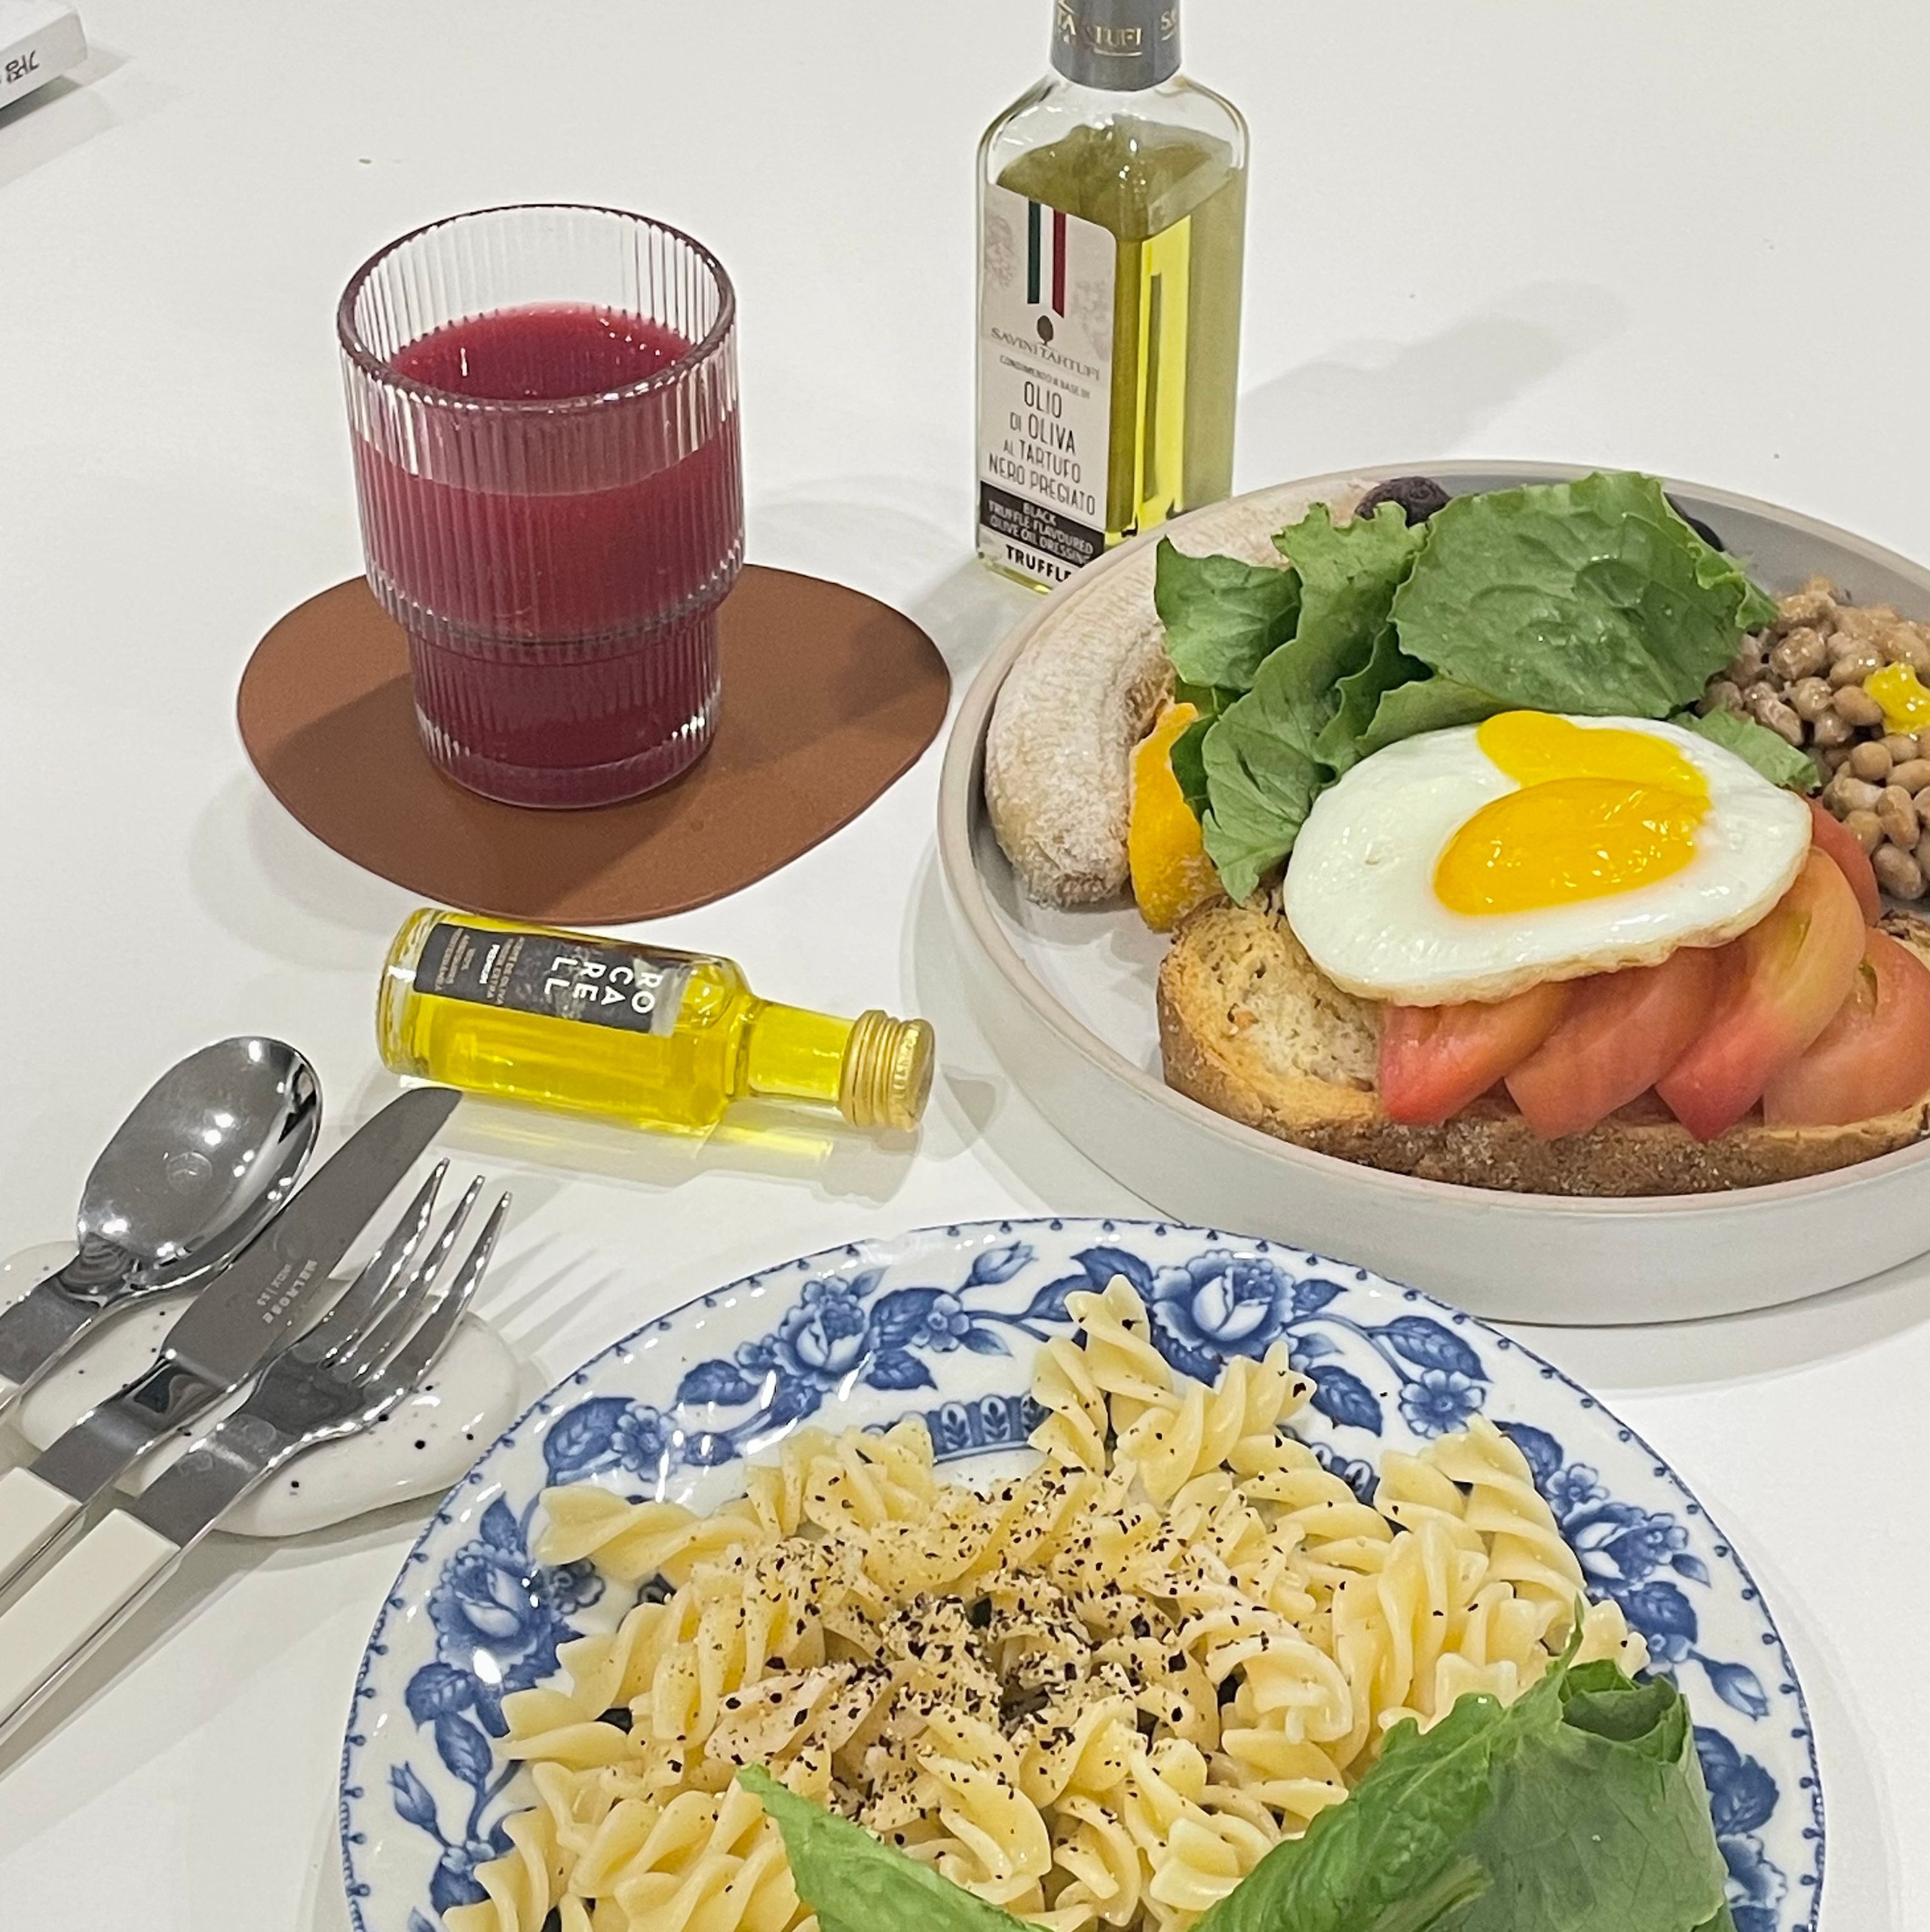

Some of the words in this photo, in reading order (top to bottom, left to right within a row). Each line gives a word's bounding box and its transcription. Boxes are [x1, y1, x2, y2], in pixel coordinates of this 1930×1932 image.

[1024, 381, 1062, 419] OLIO
[1009, 412, 1022, 432] DI
[1028, 413, 1076, 457] OLIVA
[1003, 440, 1015, 457] AL
[1019, 439, 1081, 483] TARTUFO
[989, 452, 1025, 485] NERO
[1031, 471, 1095, 516] PREGIATO
[988, 499, 1031, 528] TRUFFLE
[1034, 520, 1094, 555] FLAVOURED
[1022, 502, 1057, 526] BLACK
[1021, 529, 1038, 545] OIL
